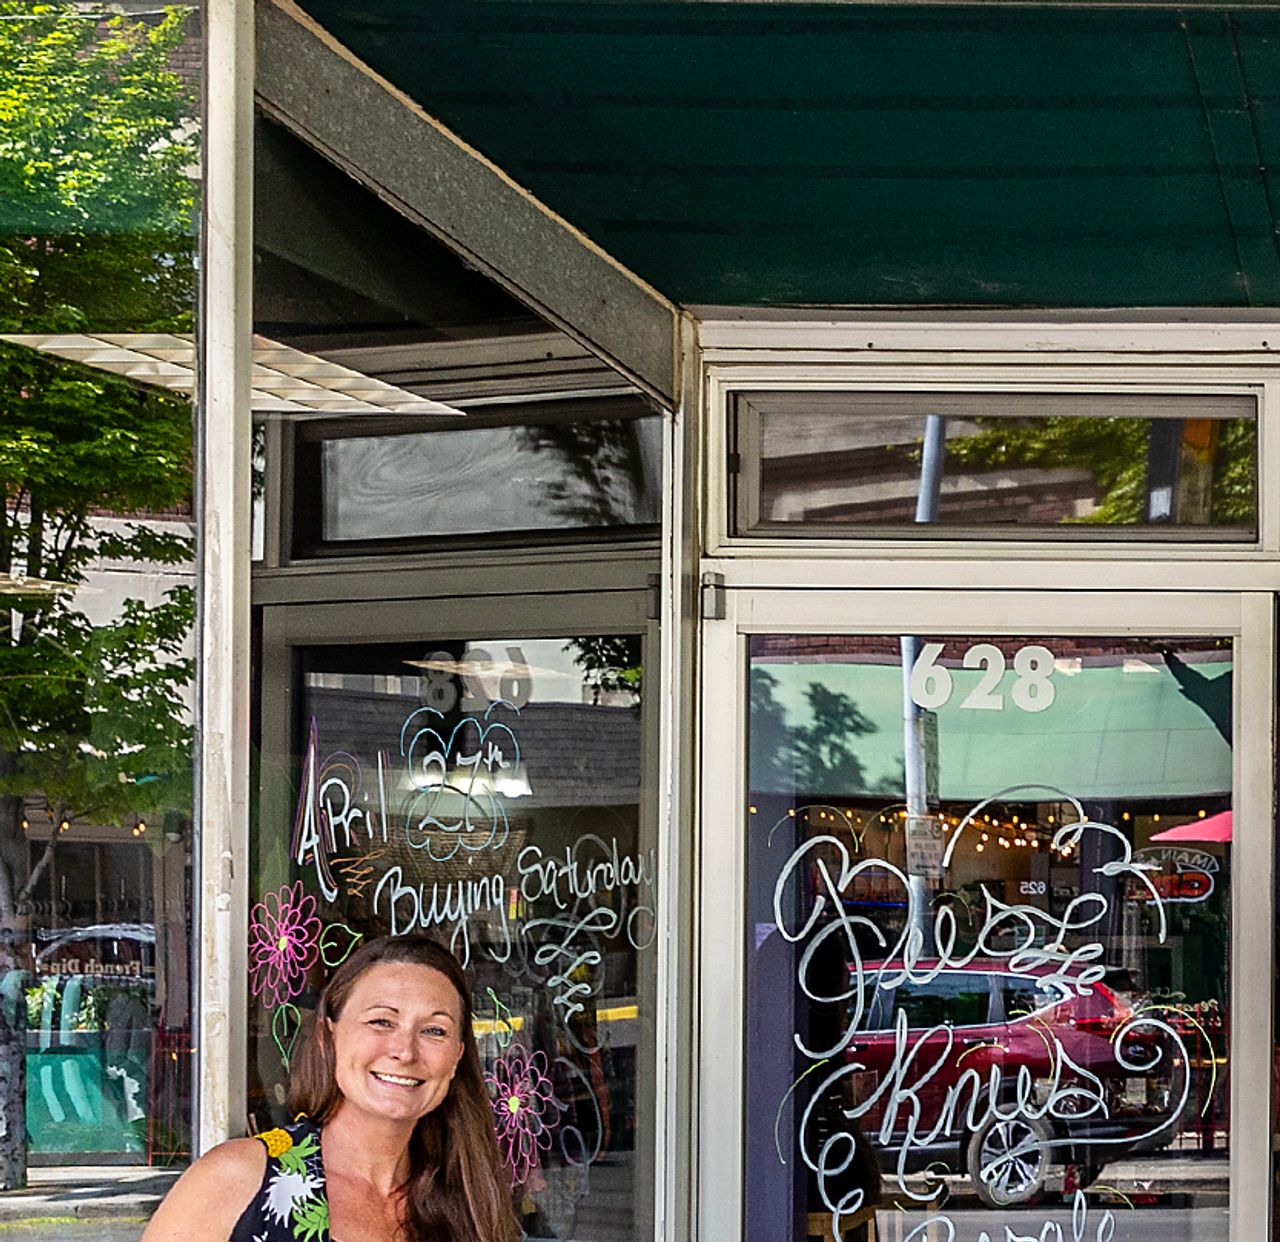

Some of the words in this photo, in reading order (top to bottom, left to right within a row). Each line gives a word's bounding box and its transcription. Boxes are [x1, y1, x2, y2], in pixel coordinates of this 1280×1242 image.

[910, 643, 1056, 713] 628
[374, 864, 512, 968] Buying
[517, 838, 658, 936] Saturday
